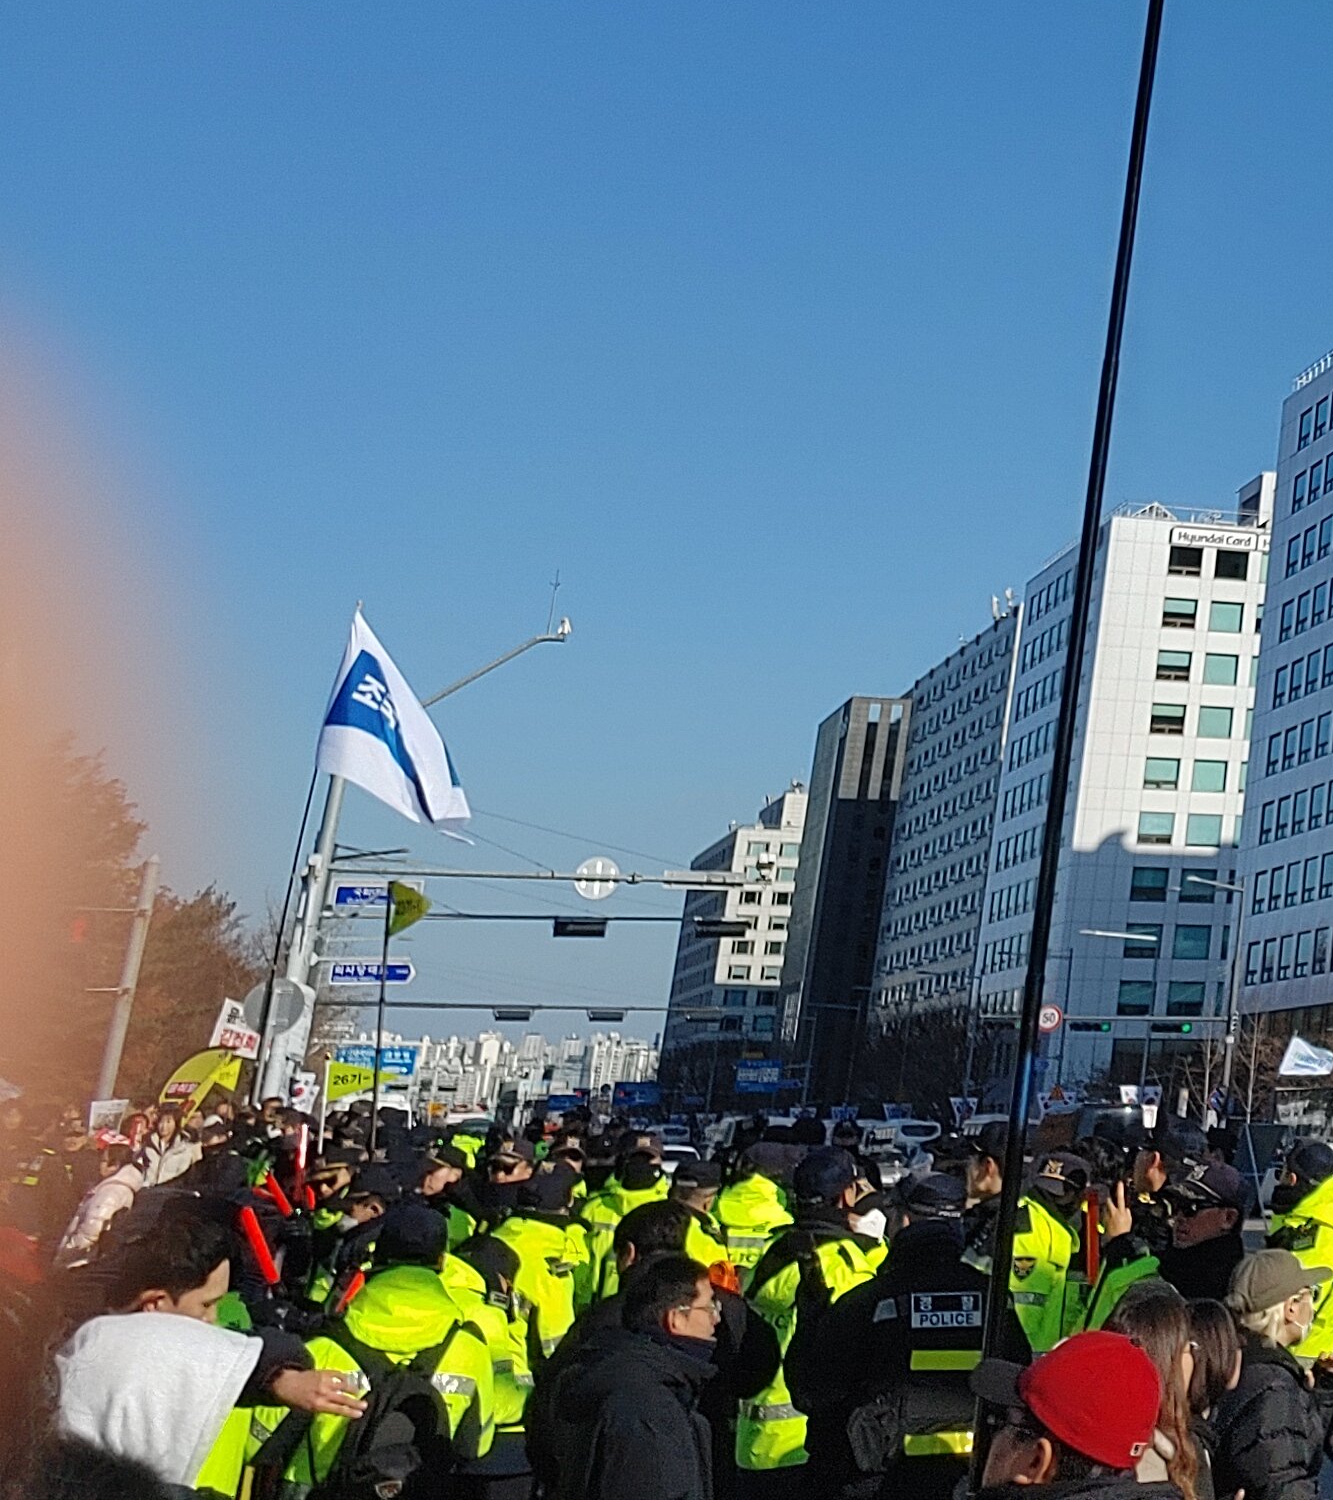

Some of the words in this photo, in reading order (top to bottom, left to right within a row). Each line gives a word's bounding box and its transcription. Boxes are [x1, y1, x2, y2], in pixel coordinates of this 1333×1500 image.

[1178, 531, 1225, 547] Hyundai
[1226, 535, 1252, 547] Card
[1042, 1012, 1056, 1024] 50
[919, 1313, 975, 1326] POLICE
